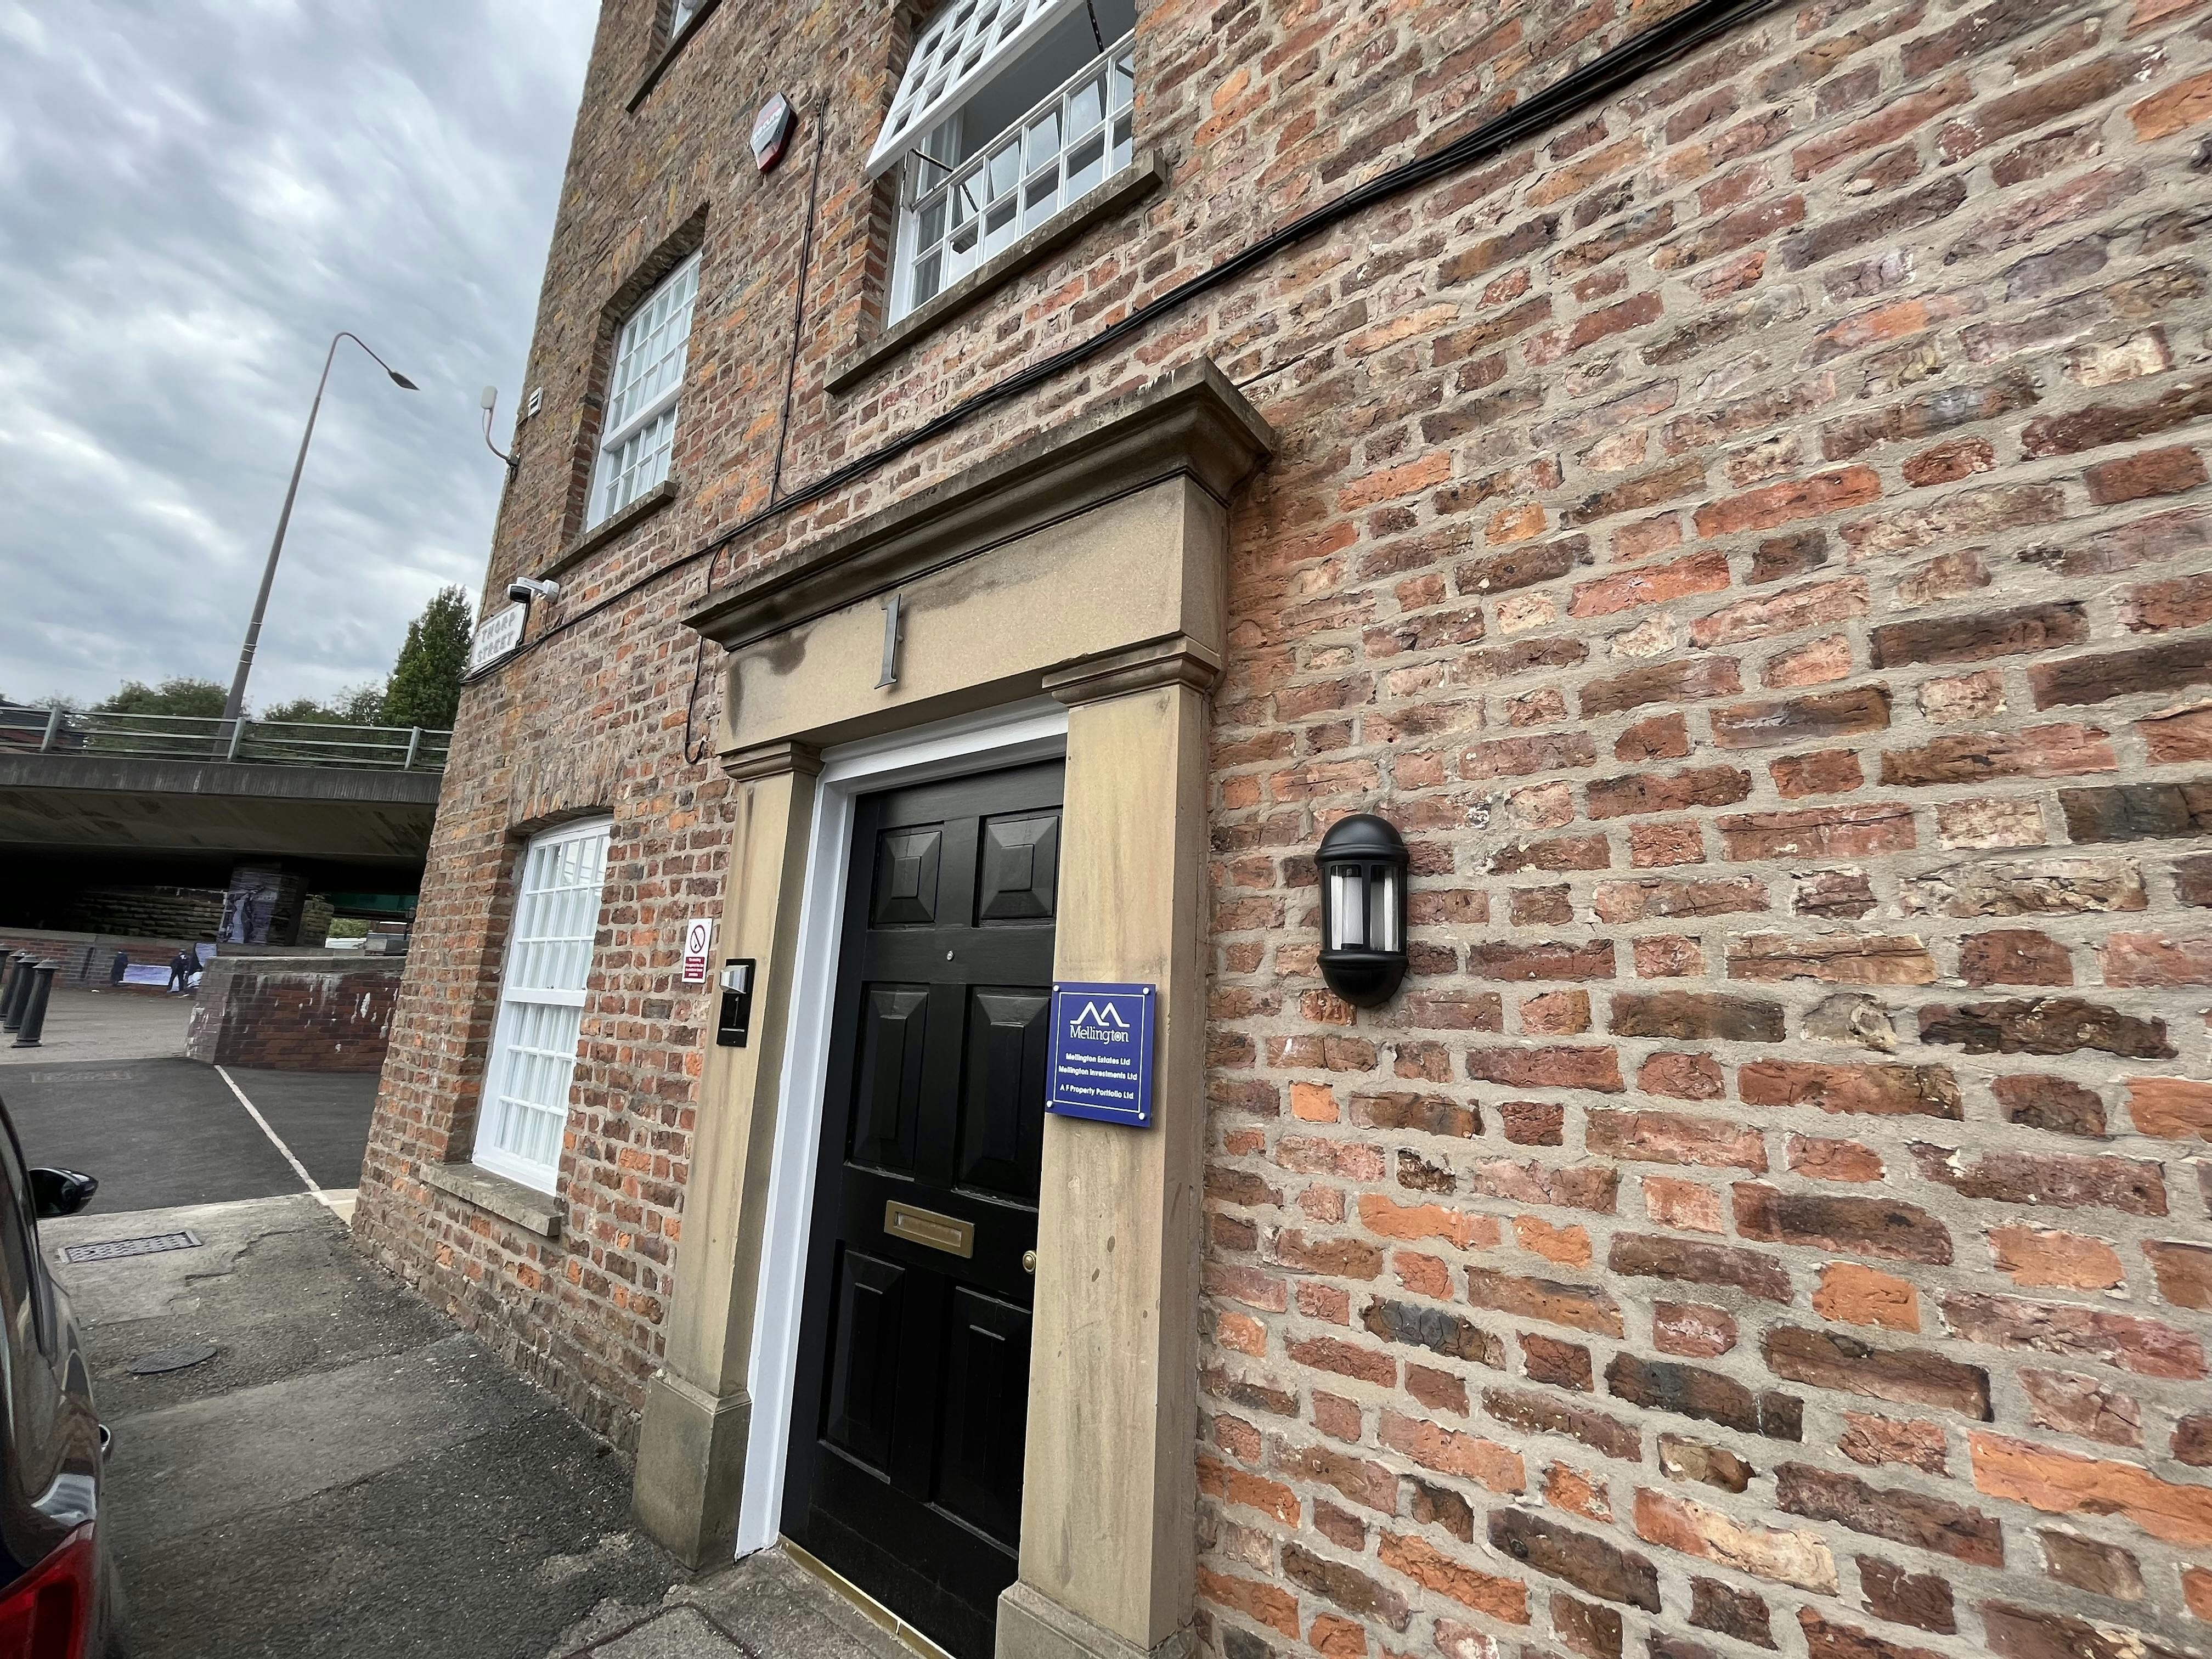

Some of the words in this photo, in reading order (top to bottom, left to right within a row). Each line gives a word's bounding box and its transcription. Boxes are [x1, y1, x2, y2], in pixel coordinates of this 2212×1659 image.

[482, 611, 516, 643] THORP
[477, 630, 515, 663] STREET
[874, 593, 901, 690] 1
[1070, 1024, 1130, 1045] Mellington
[1065, 1053, 1097, 1063] Mellington
[1097, 1056, 1119, 1065] Estates
[1058, 1065, 1089, 1076] Mellington
[1090, 1069, 1126, 1079] Investments
[1127, 1073, 1138, 1081] Ltd
[1070, 1085, 1096, 1096] Property
[1096, 1088, 1122, 1098] Portfolio
[1123, 1091, 1134, 1099] Ltd
